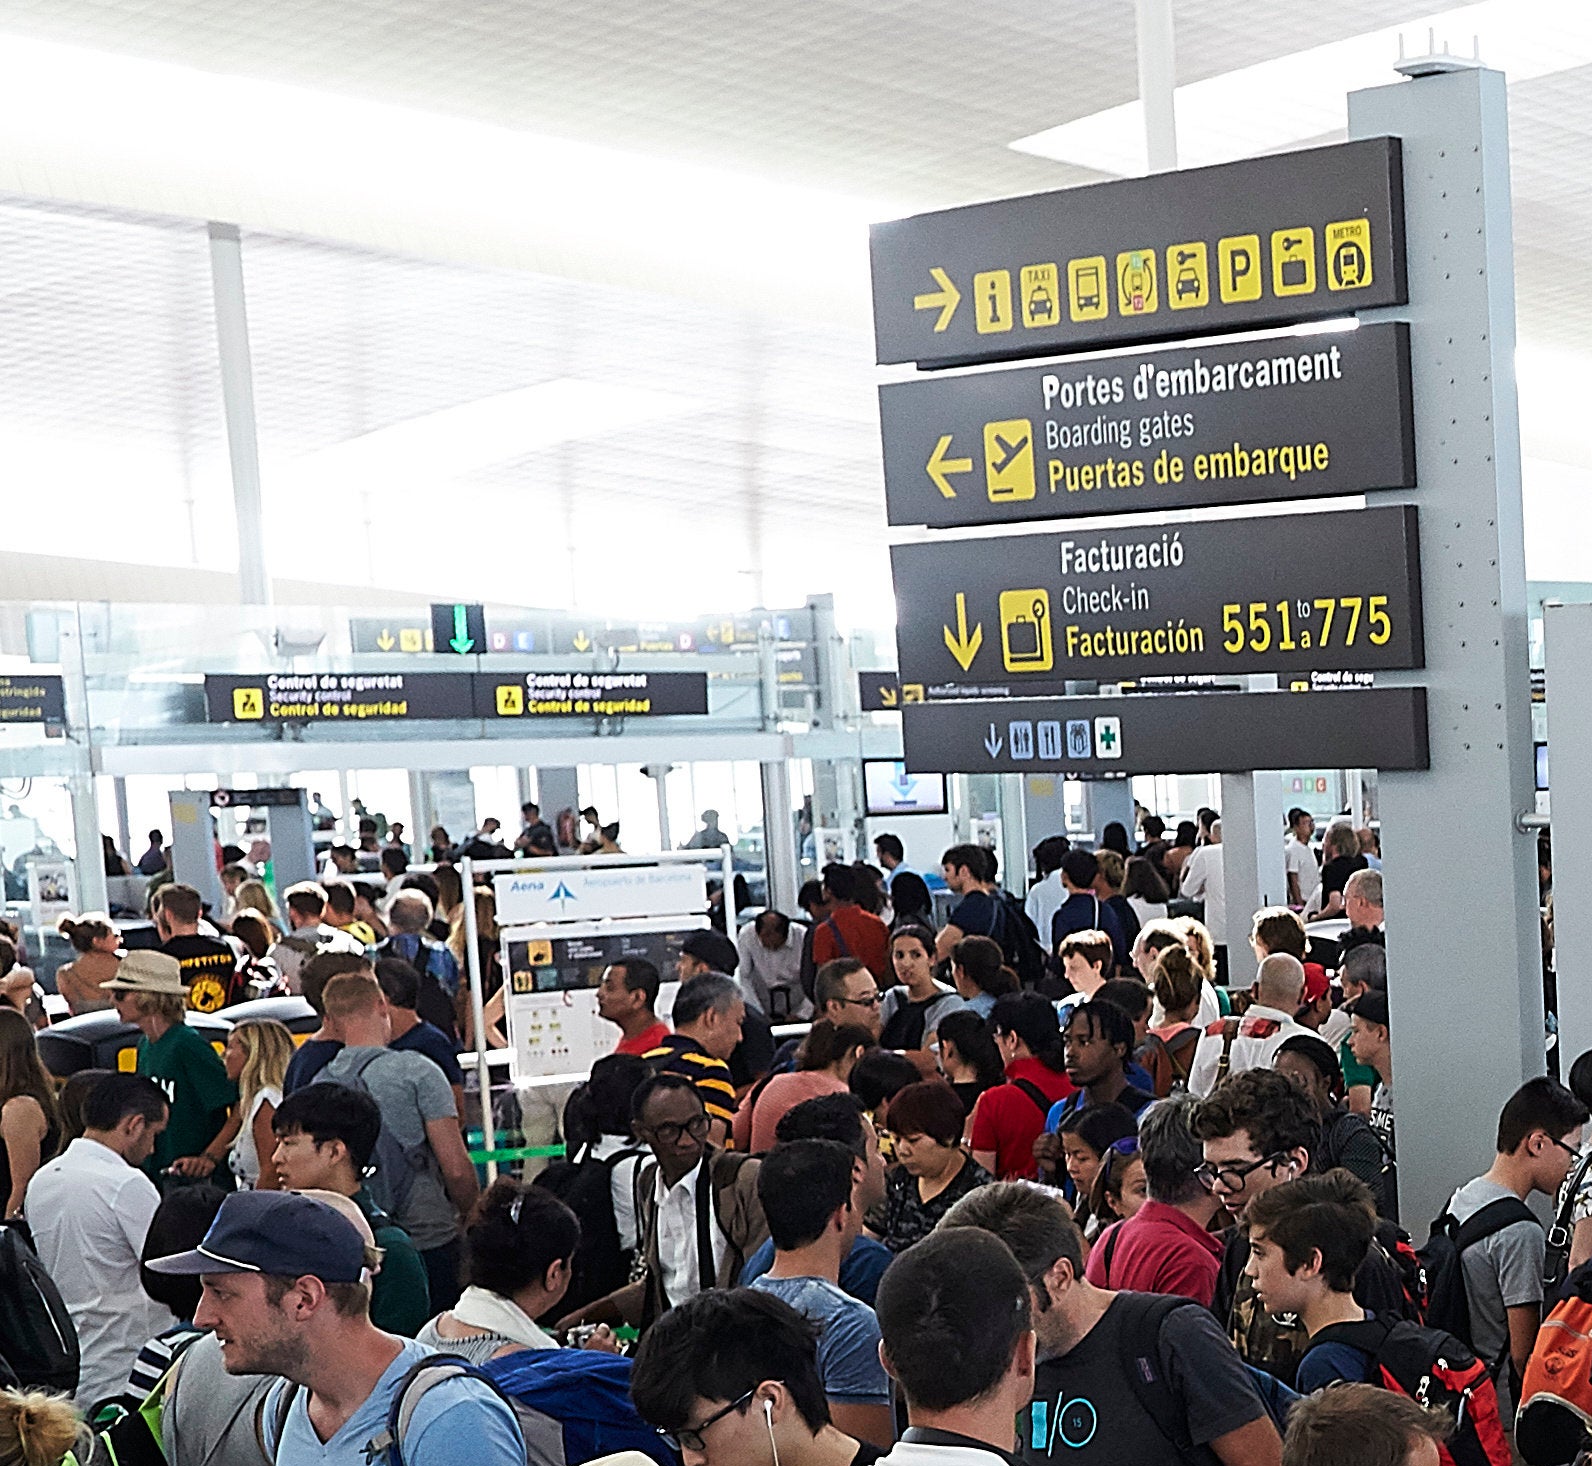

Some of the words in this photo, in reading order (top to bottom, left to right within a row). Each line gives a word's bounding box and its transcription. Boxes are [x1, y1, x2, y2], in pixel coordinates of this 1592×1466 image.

[1333, 225, 1362, 239] METRO
[1027, 269, 1051, 284] TAXI
[1042, 375, 1124, 410] Portes
[1133, 346, 1342, 401] d'embarcament
[1046, 412, 1131, 449] Boarding
[1139, 410, 1194, 447] gates
[1048, 458, 1144, 493] Puertas
[1153, 450, 1183, 485] de
[1194, 442, 1329, 480] embarque
[1061, 532, 1184, 574] Facturació
[1062, 583, 1149, 614] Check-in
[1223, 601, 1296, 654] 551
[1297, 600, 1310, 618] to
[1314, 596, 1391, 647] 775
[1066, 619, 1204, 657] Facturación
[1301, 629, 1311, 649] a
[267, 675, 318, 689] Control
[320, 674, 337, 689] de
[341, 675, 403, 691] seguretat
[526, 673, 571, 688] Control
[573, 673, 590, 688] de
[591, 674, 647, 690] seguretat
[1311, 671, 1340, 683] Control
[269, 690, 312, 703] Security
[315, 690, 352, 702] control
[527, 688, 566, 700] Security
[568, 688, 601, 699] control
[270, 702, 319, 716] Control
[322, 701, 339, 716] de
[343, 701, 407, 718] seguridad
[528, 700, 572, 713] Control
[575, 700, 590, 713] de
[593, 699, 650, 715] seguridad
[511, 881, 544, 892] Aena
